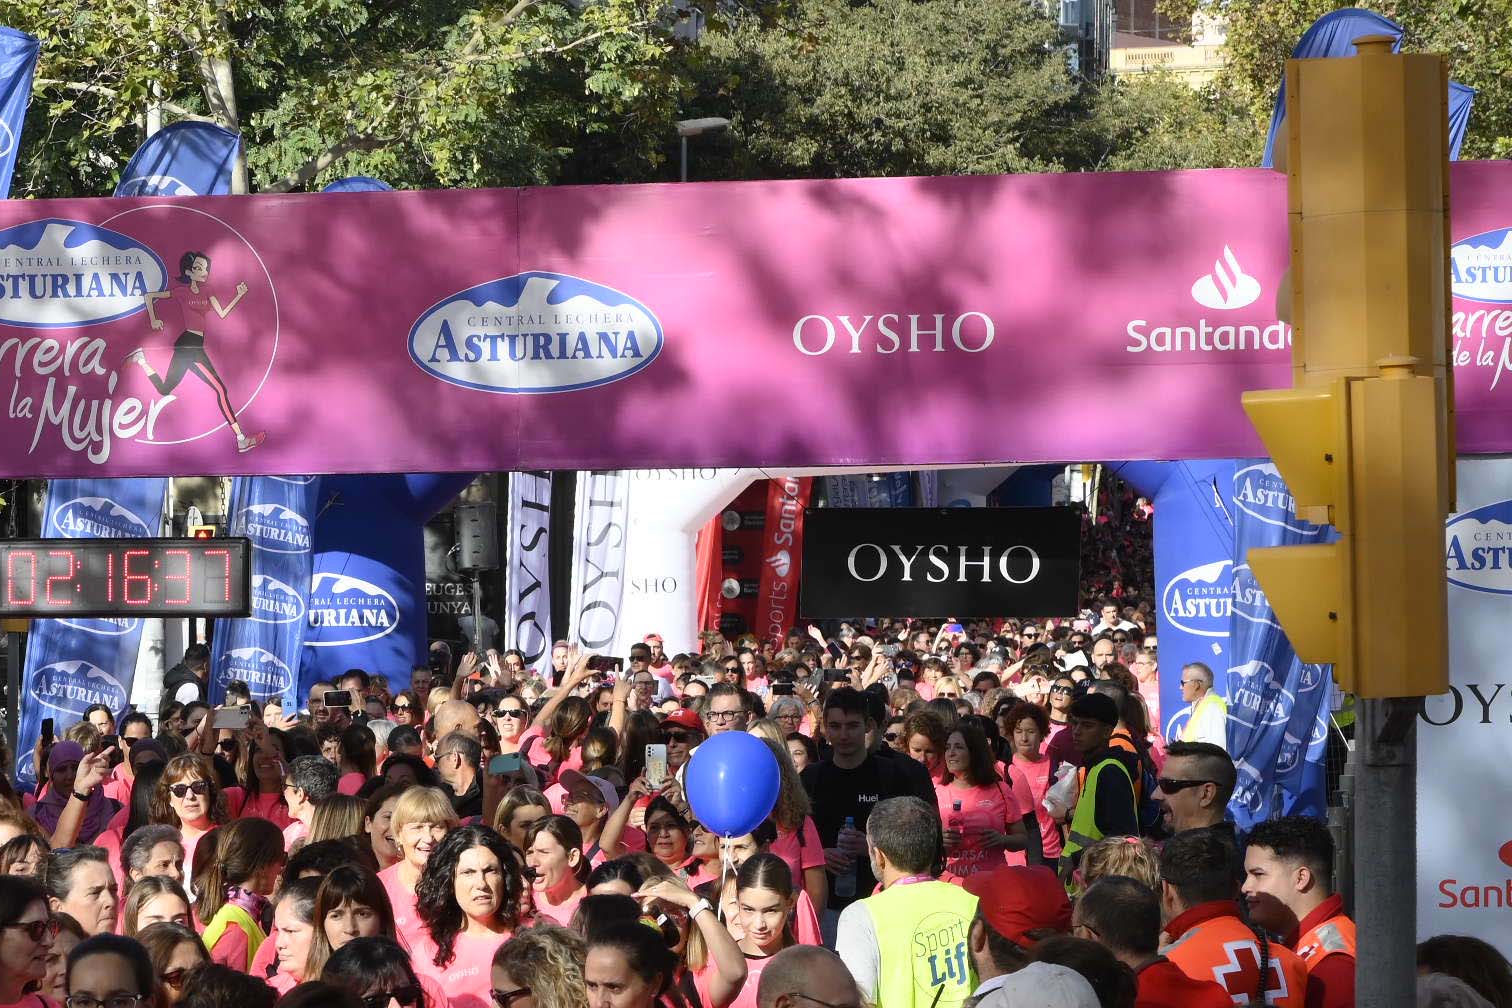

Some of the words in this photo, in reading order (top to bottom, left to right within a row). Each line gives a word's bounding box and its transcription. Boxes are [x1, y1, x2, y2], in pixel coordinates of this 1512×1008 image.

[70, 255, 143, 267] LECHERA
[467, 315, 545, 327] CENTRAL
[554, 312, 634, 325] LECHERA
[794, 312, 996, 355] OYSHO
[1126, 318, 1292, 353] Santand
[428, 319, 643, 363] ASTURIANA
[1477, 338, 1494, 367] la
[8, 380, 33, 419] la
[28, 366, 177, 465] Mujer
[237, 516, 311, 547] ASTURIANA
[7, 550, 230, 605] 02:16:37
[847, 543, 1041, 584] OYSHO
[309, 608, 390, 627] URIANA
[337, 597, 385, 607] LECHERA
[36, 674, 120, 711] ASTURIANA
[1418, 683, 1512, 725] OY
[914, 918, 967, 958] Sport
